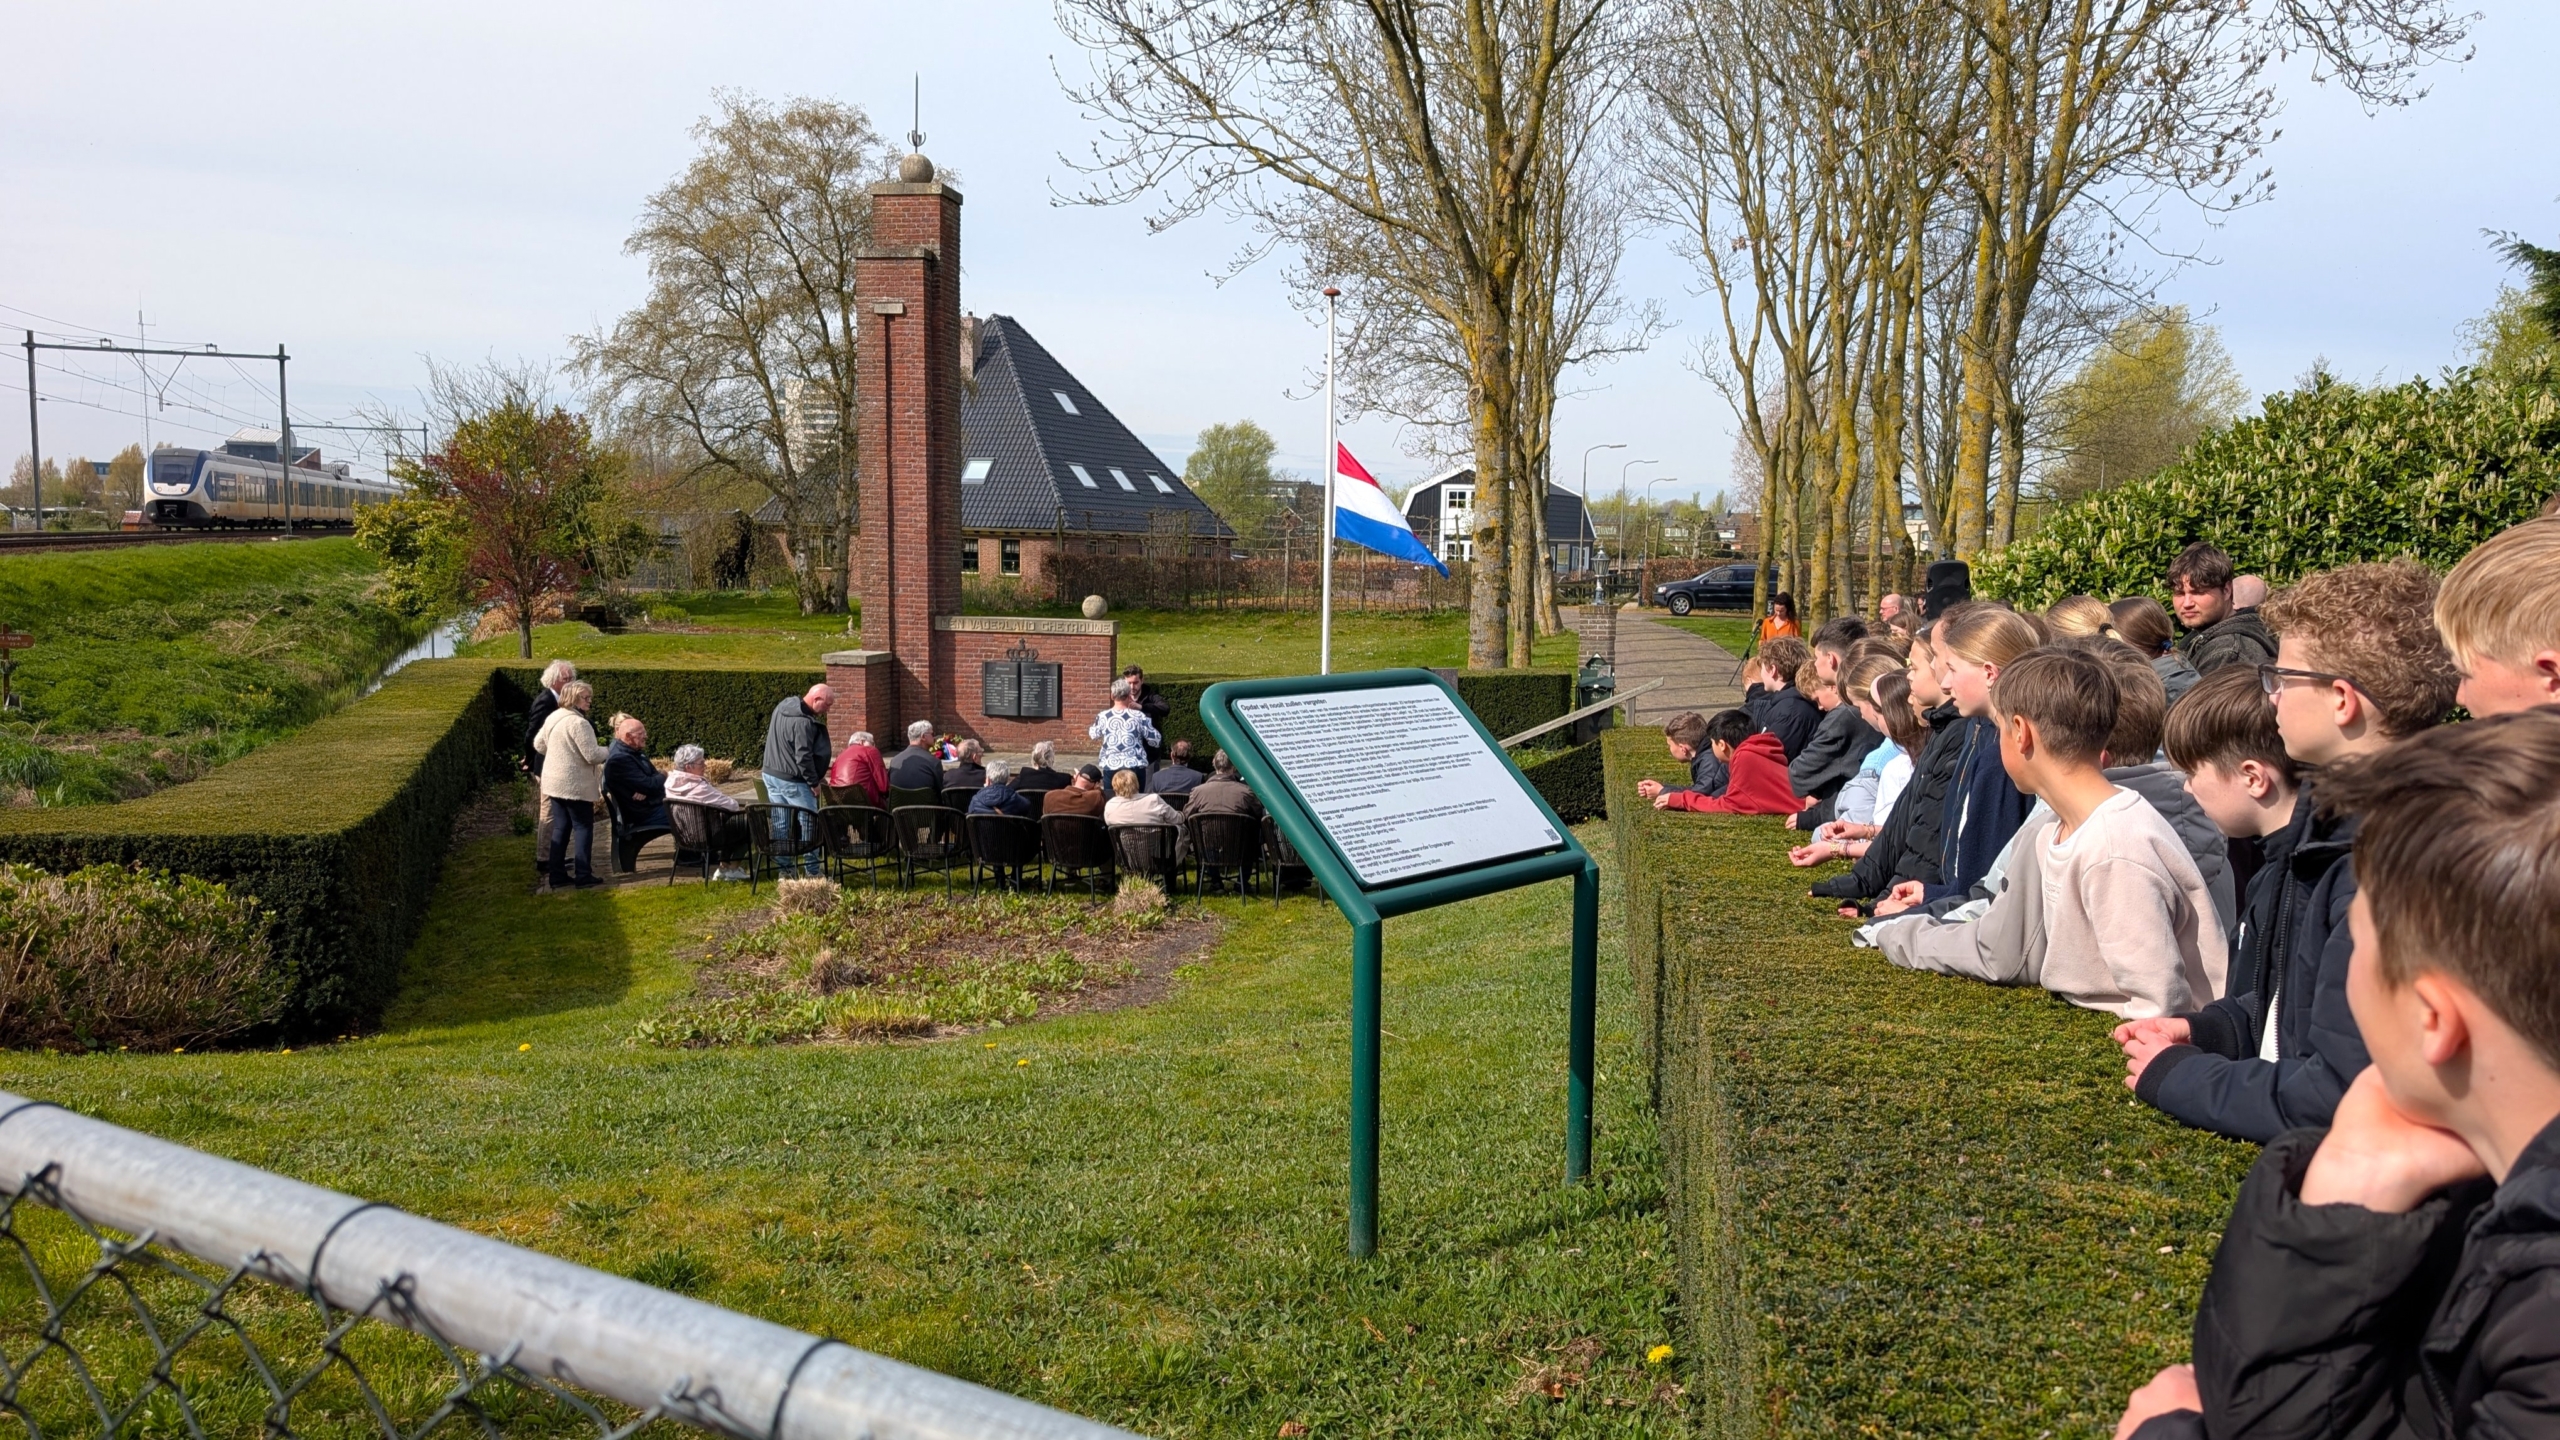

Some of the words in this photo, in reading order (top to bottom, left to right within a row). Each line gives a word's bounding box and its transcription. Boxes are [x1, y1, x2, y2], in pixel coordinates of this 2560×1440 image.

[941, 618, 964, 630] DEN
[969, 619, 1035, 632] VADERLAND
[1041, 621, 1111, 634] GHETROUWE
